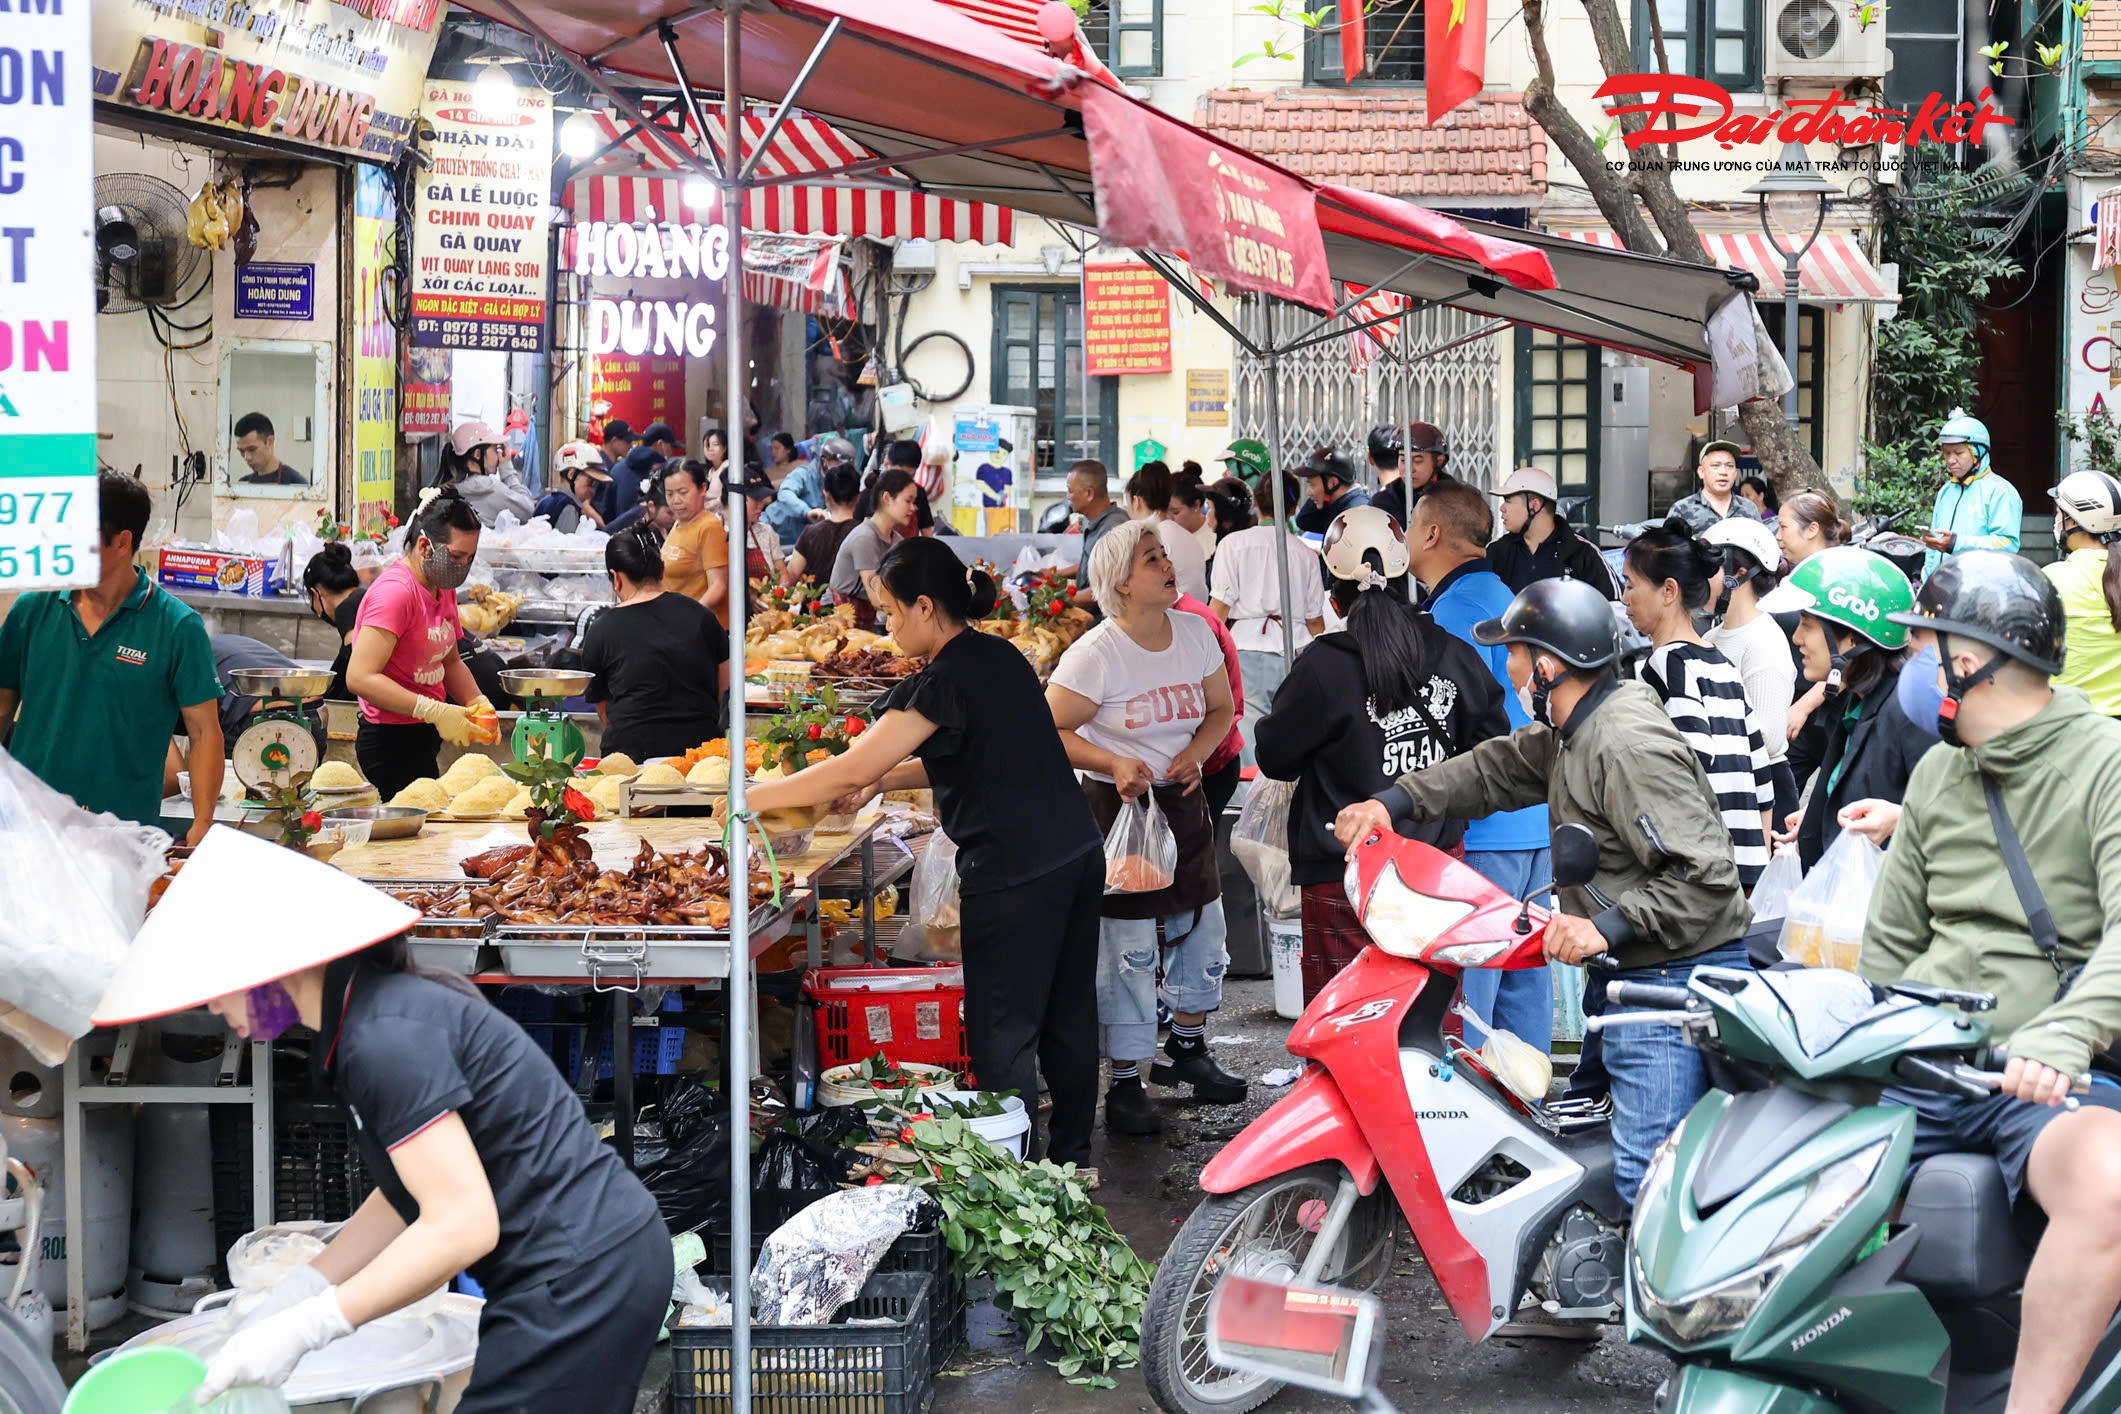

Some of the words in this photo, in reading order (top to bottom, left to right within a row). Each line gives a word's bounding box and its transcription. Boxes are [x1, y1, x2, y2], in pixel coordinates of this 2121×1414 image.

[137, 31, 285, 128] HOÀNG
[282, 78, 376, 148] DUNG
[429, 89, 448, 102] GÀ
[427, 183, 454, 201] GÀ
[460, 183, 482, 203] LỄ
[489, 189, 538, 209] LUỘC
[428, 209, 480, 227] CHIM
[487, 213, 535, 230] QUAY
[440, 231, 466, 250] GÀ
[474, 236, 522, 253] QUAY
[575, 204, 730, 281] HOÀNG
[421, 256, 440, 275] VỊT
[443, 258, 474, 275] QUAY
[478, 260, 510, 279] LẠNG
[515, 261, 540, 279] SƠN
[248, 286, 276, 300] HOÀNG
[278, 289, 301, 301] DUNG
[422, 275, 449, 290] XÔI
[454, 277, 485, 292] CÁC
[489, 283, 537, 297] LOẠI...
[416, 298, 439, 313] NGON
[441, 298, 458, 317] ĐẶC
[460, 298, 479, 317] BIỆT
[484, 299, 499, 315] GIÁ
[500, 300, 512, 316] CẢ
[513, 303, 529, 321] HỢP
[530, 302, 541, 318] LÝ
[418, 319, 439, 332] ĐT:
[443, 321, 478, 333] 0978
[482, 323, 517, 336] 5555
[521, 325, 538, 337] 66
[588, 299, 717, 357] DUNG
[442, 334, 478, 346] 0912
[481, 336, 507, 348] 287
[512, 337, 537, 350] 640
[1242, 450, 1261, 463] Grab
[166, 554, 211, 566] ANNAPURNA
[1828, 586, 1880, 621] Grab
[116, 645, 148, 660] TOTAL
[1415, 1111, 1469, 1120] HONDA
[1791, 1306, 1853, 1352] HONDA
